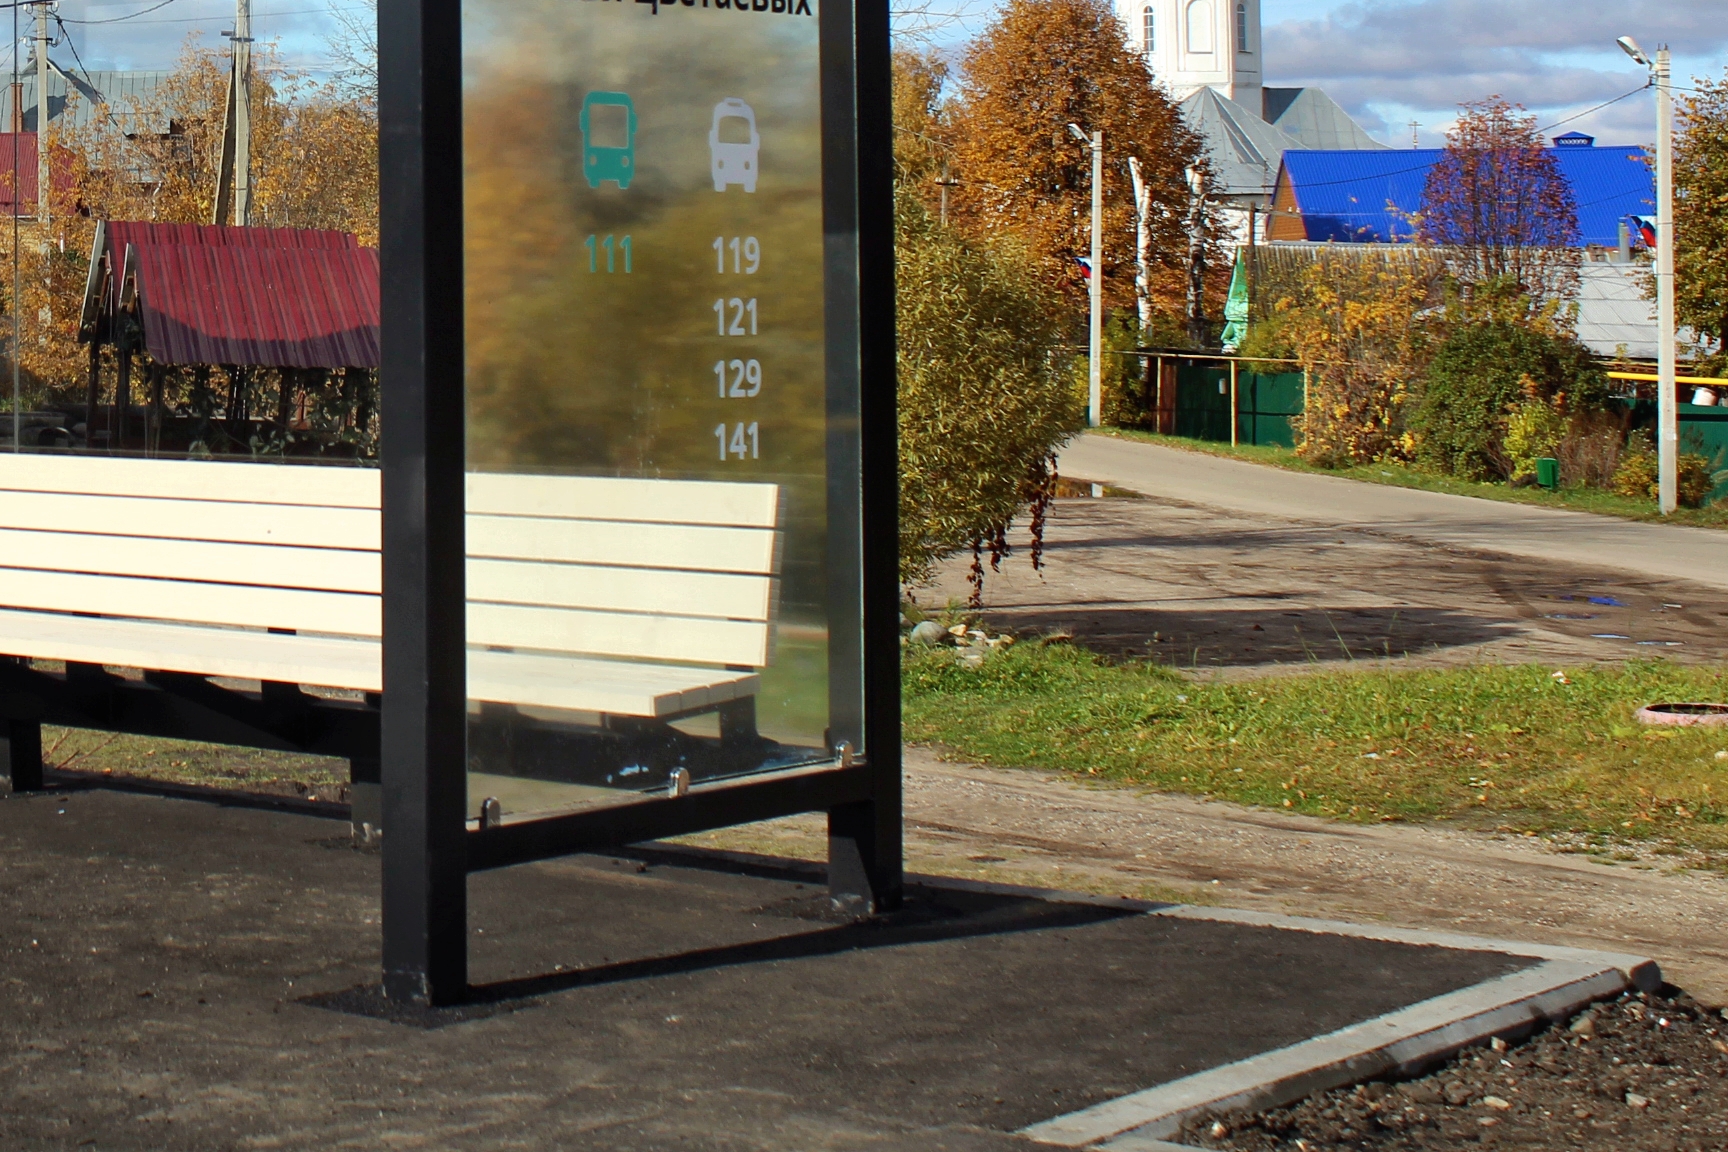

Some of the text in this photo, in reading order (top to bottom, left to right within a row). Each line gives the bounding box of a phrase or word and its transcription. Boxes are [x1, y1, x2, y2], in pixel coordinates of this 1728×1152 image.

[584, 234, 632, 273] 111
[713, 236, 761, 275] 119
[713, 297, 758, 336] 121
[714, 358, 762, 398] 129
[714, 421, 759, 461] 141
